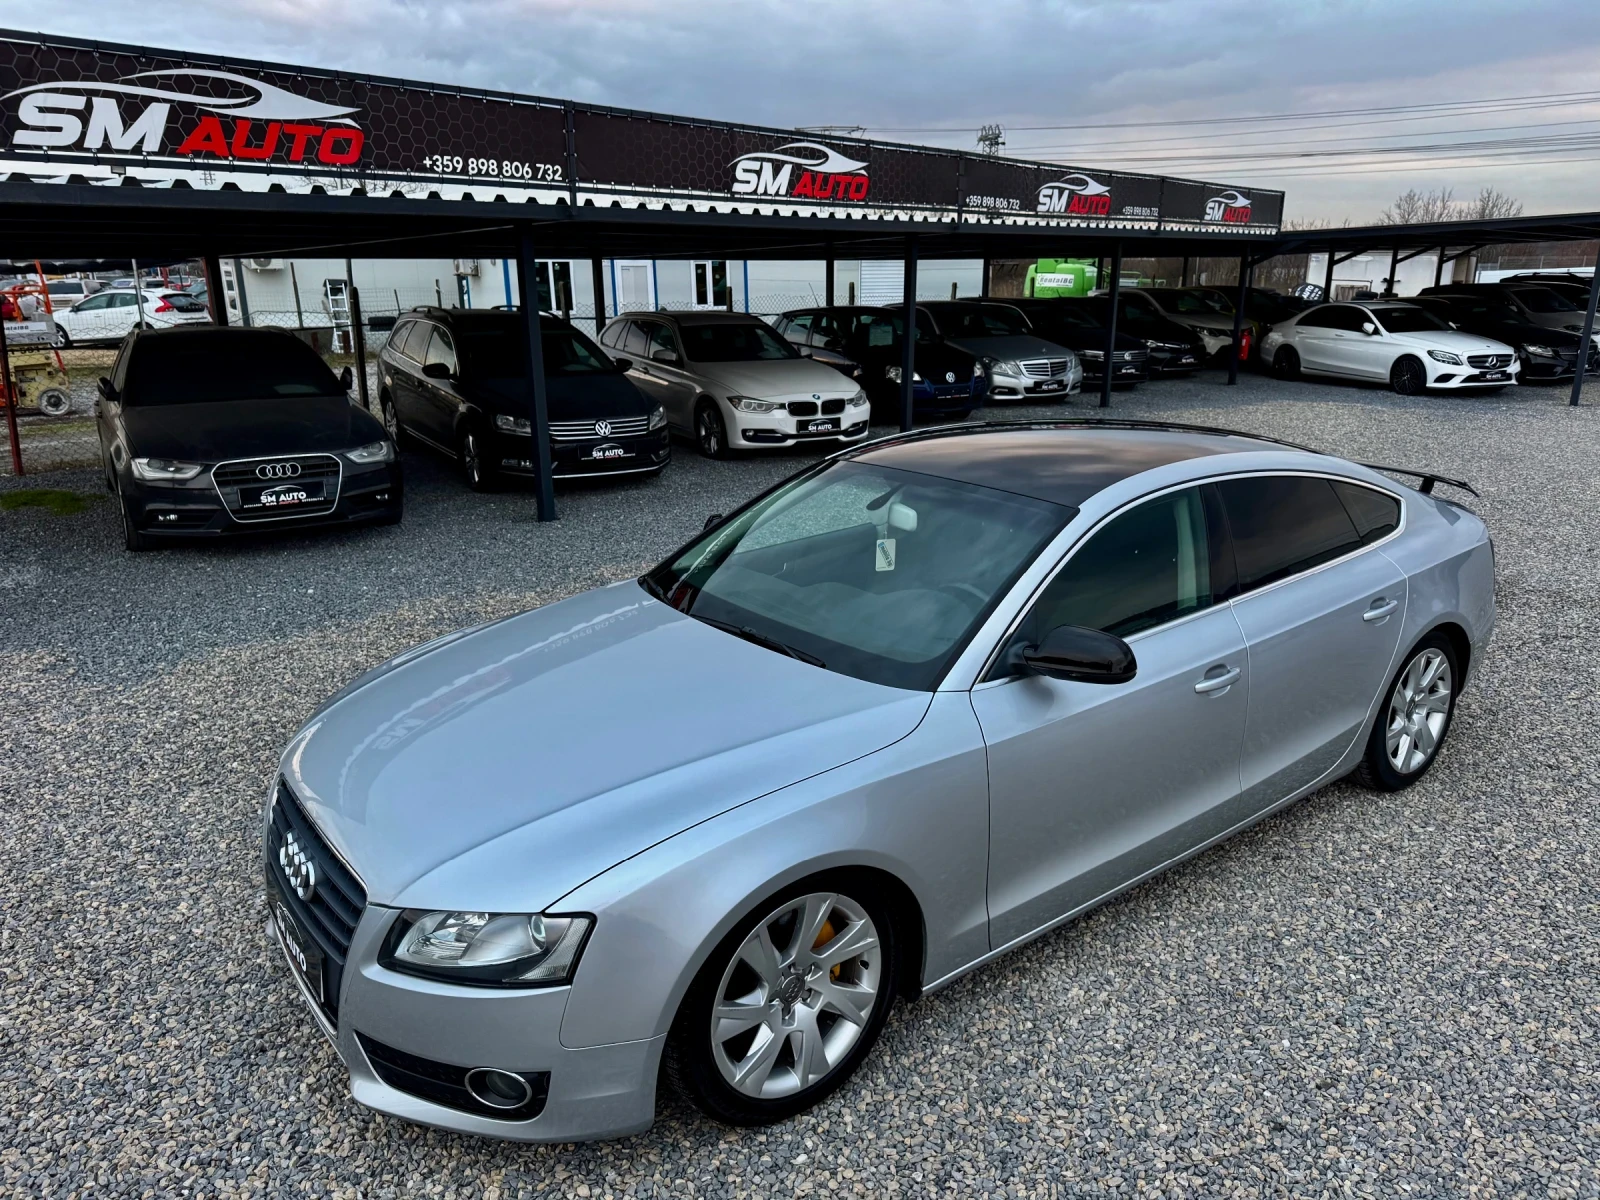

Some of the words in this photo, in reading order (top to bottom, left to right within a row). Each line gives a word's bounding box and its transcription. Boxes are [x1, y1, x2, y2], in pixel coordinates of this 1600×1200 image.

[12, 92, 171, 152] SM
[176, 116, 364, 165] AUTO
[423, 155, 463, 172] +359
[468, 158, 498, 175] 898
[502, 161, 532, 179] 806
[536, 163, 562, 181] 732
[731, 159, 793, 196] SM
[792, 171, 870, 200] AUTO
[965, 195, 982, 207] +359
[982, 197, 996, 208] 898
[996, 198, 1008, 209] 806
[1008, 199, 1020, 210] 732
[1036, 188, 1071, 212] SM
[1067, 195, 1111, 215] AUTO
[1204, 202, 1225, 221] SM
[1223, 206, 1252, 222] AUTO
[592, 450, 603, 458] SM
[604, 448, 624, 457] AUTO
[260, 494, 277, 504] SM
[279, 491, 306, 502] AUTO
[286, 930, 306, 972] AUTO
